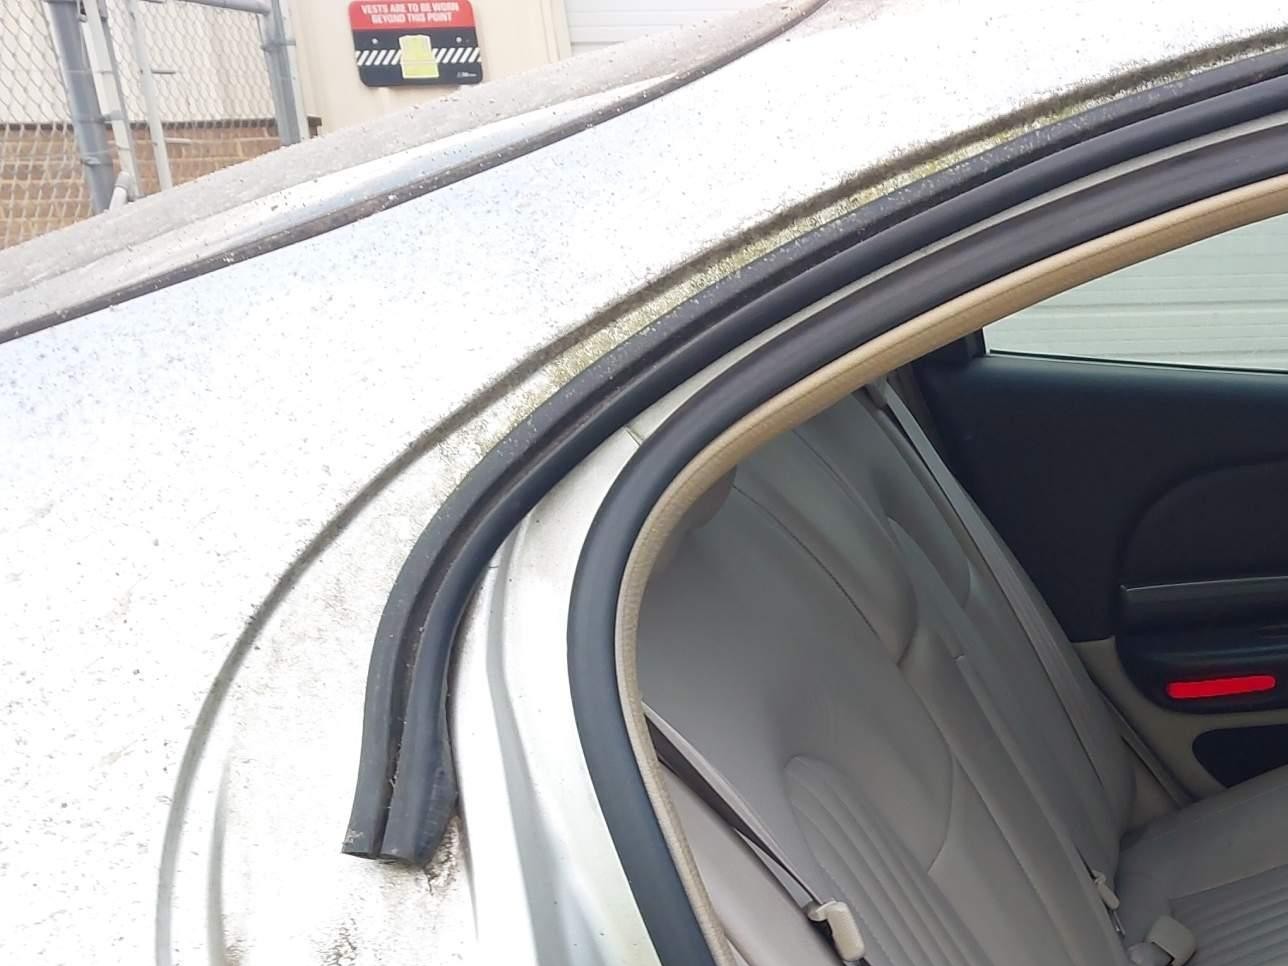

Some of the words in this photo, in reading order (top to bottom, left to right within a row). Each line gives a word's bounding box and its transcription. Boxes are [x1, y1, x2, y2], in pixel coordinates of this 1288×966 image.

[361, 5, 388, 14] VESTS
[390, 4, 406, 13] ARE
[408, 3, 419, 12] TO
[421, 3, 432, 12] BE
[432, 2, 459, 11] WORN
[371, 14, 405, 24] BEYOND
[407, 13, 426, 22] THIS
[428, 12, 452, 22] POINT
